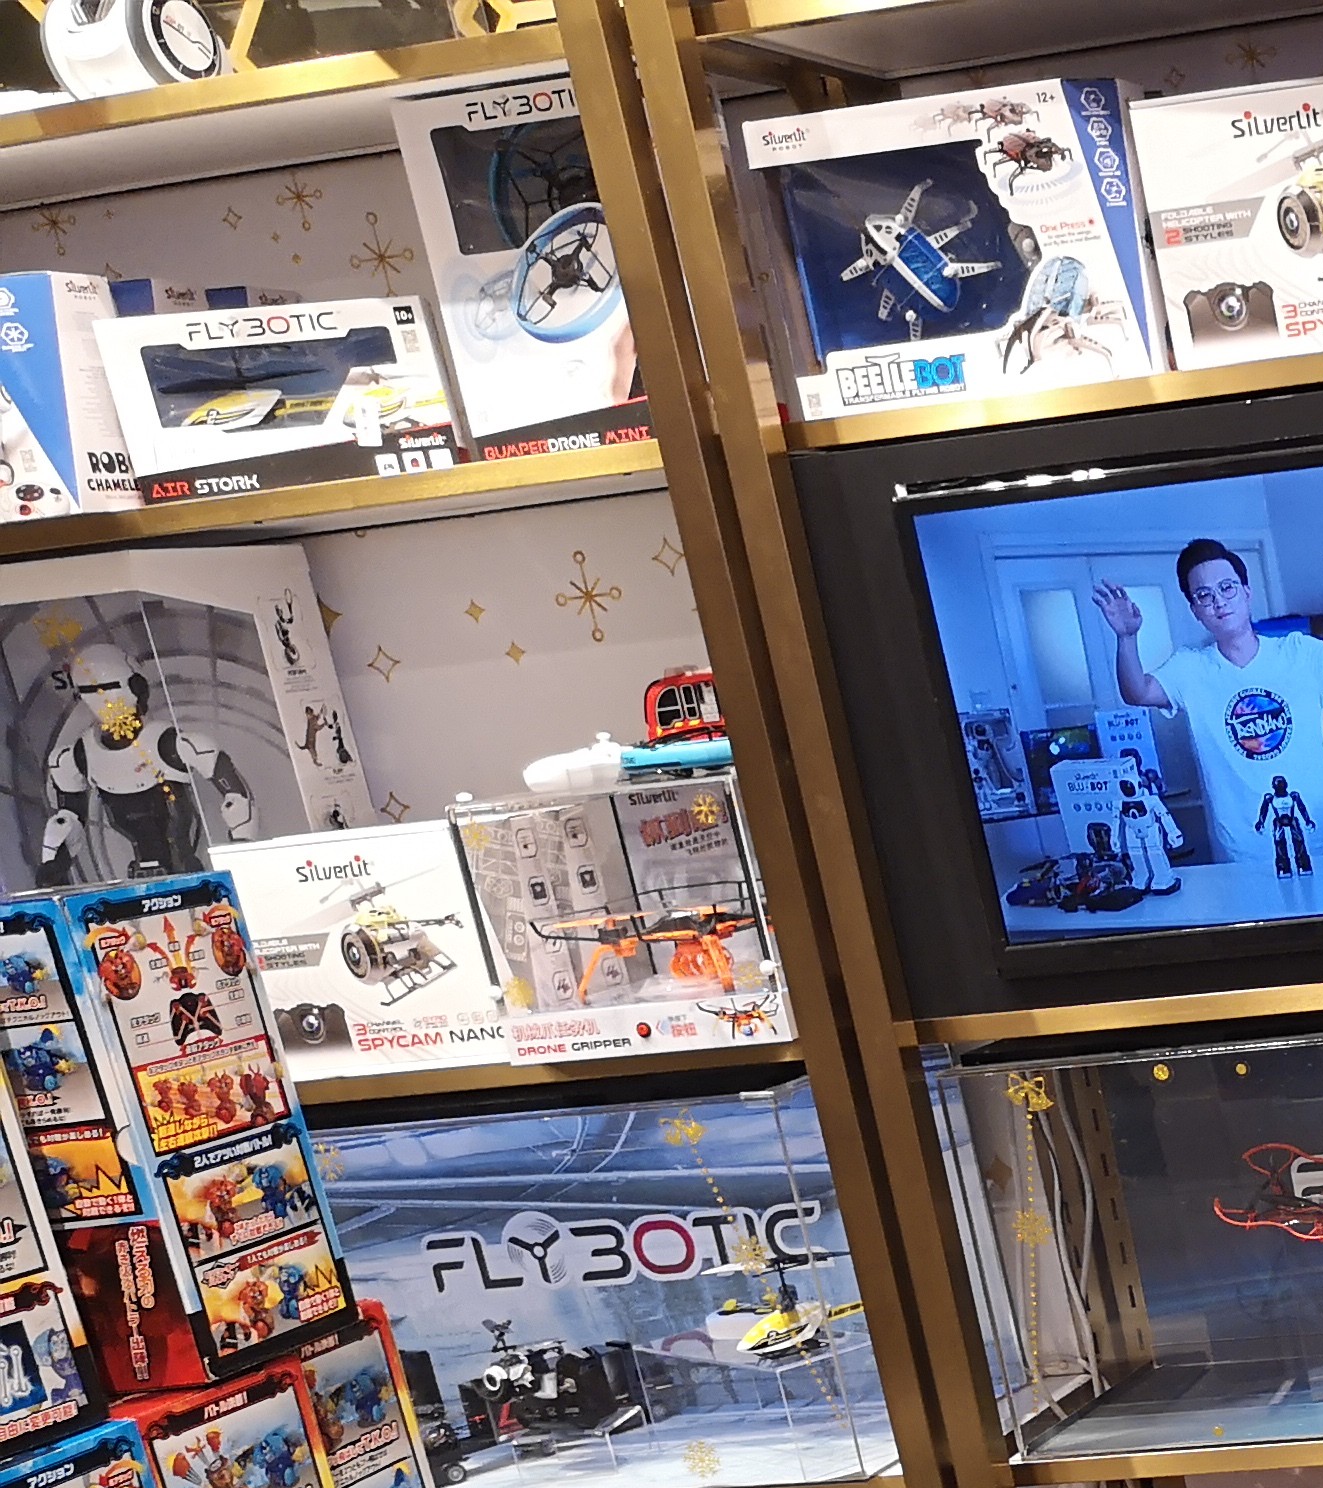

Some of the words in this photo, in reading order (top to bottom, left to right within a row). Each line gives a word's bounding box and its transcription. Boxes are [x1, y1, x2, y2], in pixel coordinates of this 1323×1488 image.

[1036, 91, 1056, 104] 12+
[1231, 103, 1323, 138] Silverlit
[762, 127, 808, 147] Silverlit
[1164, 228, 1182, 246] 2
[1281, 304, 1298, 320] 3
[186, 311, 338, 342] FLYBOTIC
[835, 353, 966, 400] BEETLEBOT
[399, 432, 448, 449] Silverlit
[484, 432, 601, 462] BUMPERDRONE
[604, 426, 651, 445] MINI
[152, 481, 190, 499] AIR
[194, 473, 260, 495] STORK
[628, 790, 680, 806] Silverlit
[296, 855, 372, 883] Silverlit
[141, 894, 182, 912] アクション
[357, 1033, 444, 1052] SPYCAM
[517, 1043, 567, 1057] DRONE
[571, 1037, 632, 1052] GRIPPER
[427, 1206, 817, 1293] FLYBOTIC
